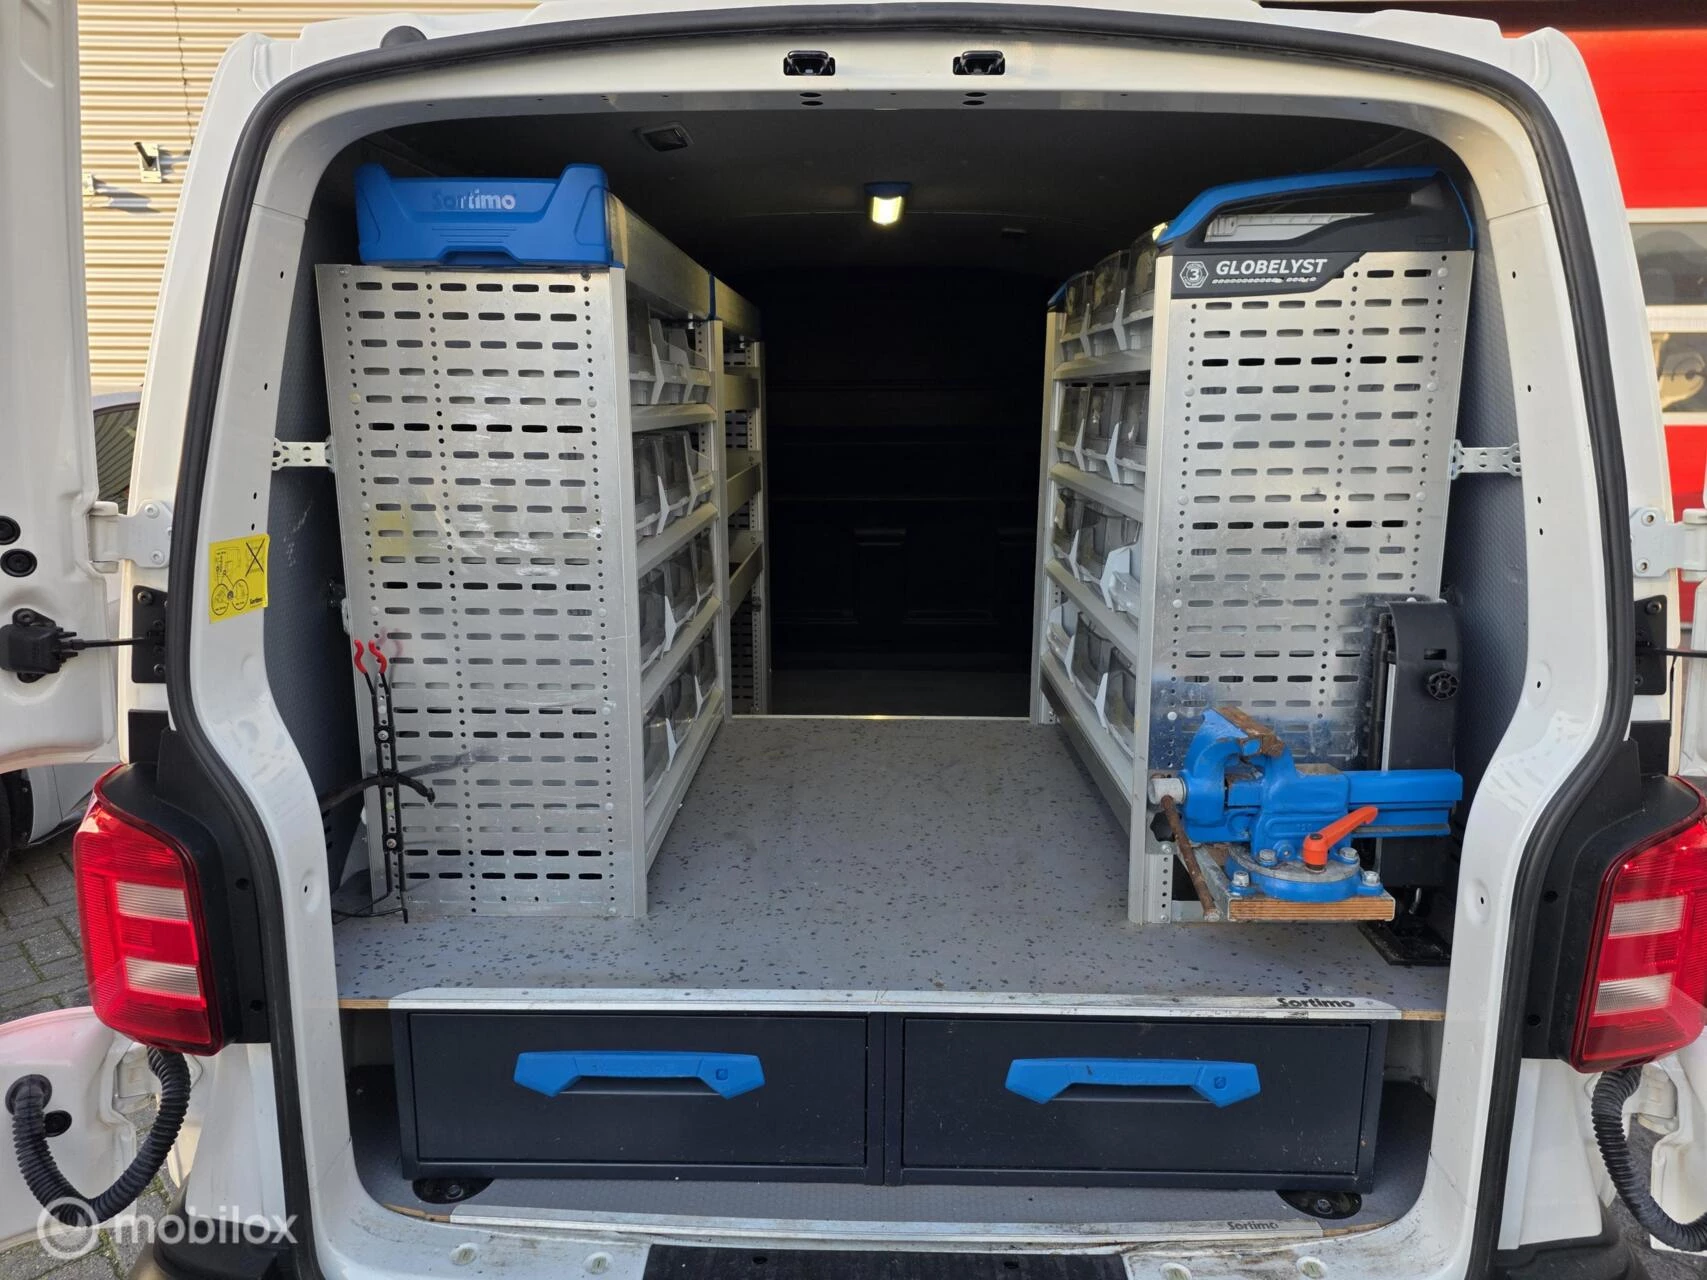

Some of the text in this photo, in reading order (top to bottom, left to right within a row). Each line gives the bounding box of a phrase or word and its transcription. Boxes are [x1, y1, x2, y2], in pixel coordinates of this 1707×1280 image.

[432, 188, 516, 210] Sortimo
[1215, 258, 1328, 275] GLOBELYST
[1276, 997, 1356, 1009] Sortimo
[1227, 1220, 1279, 1231] Sortimo
